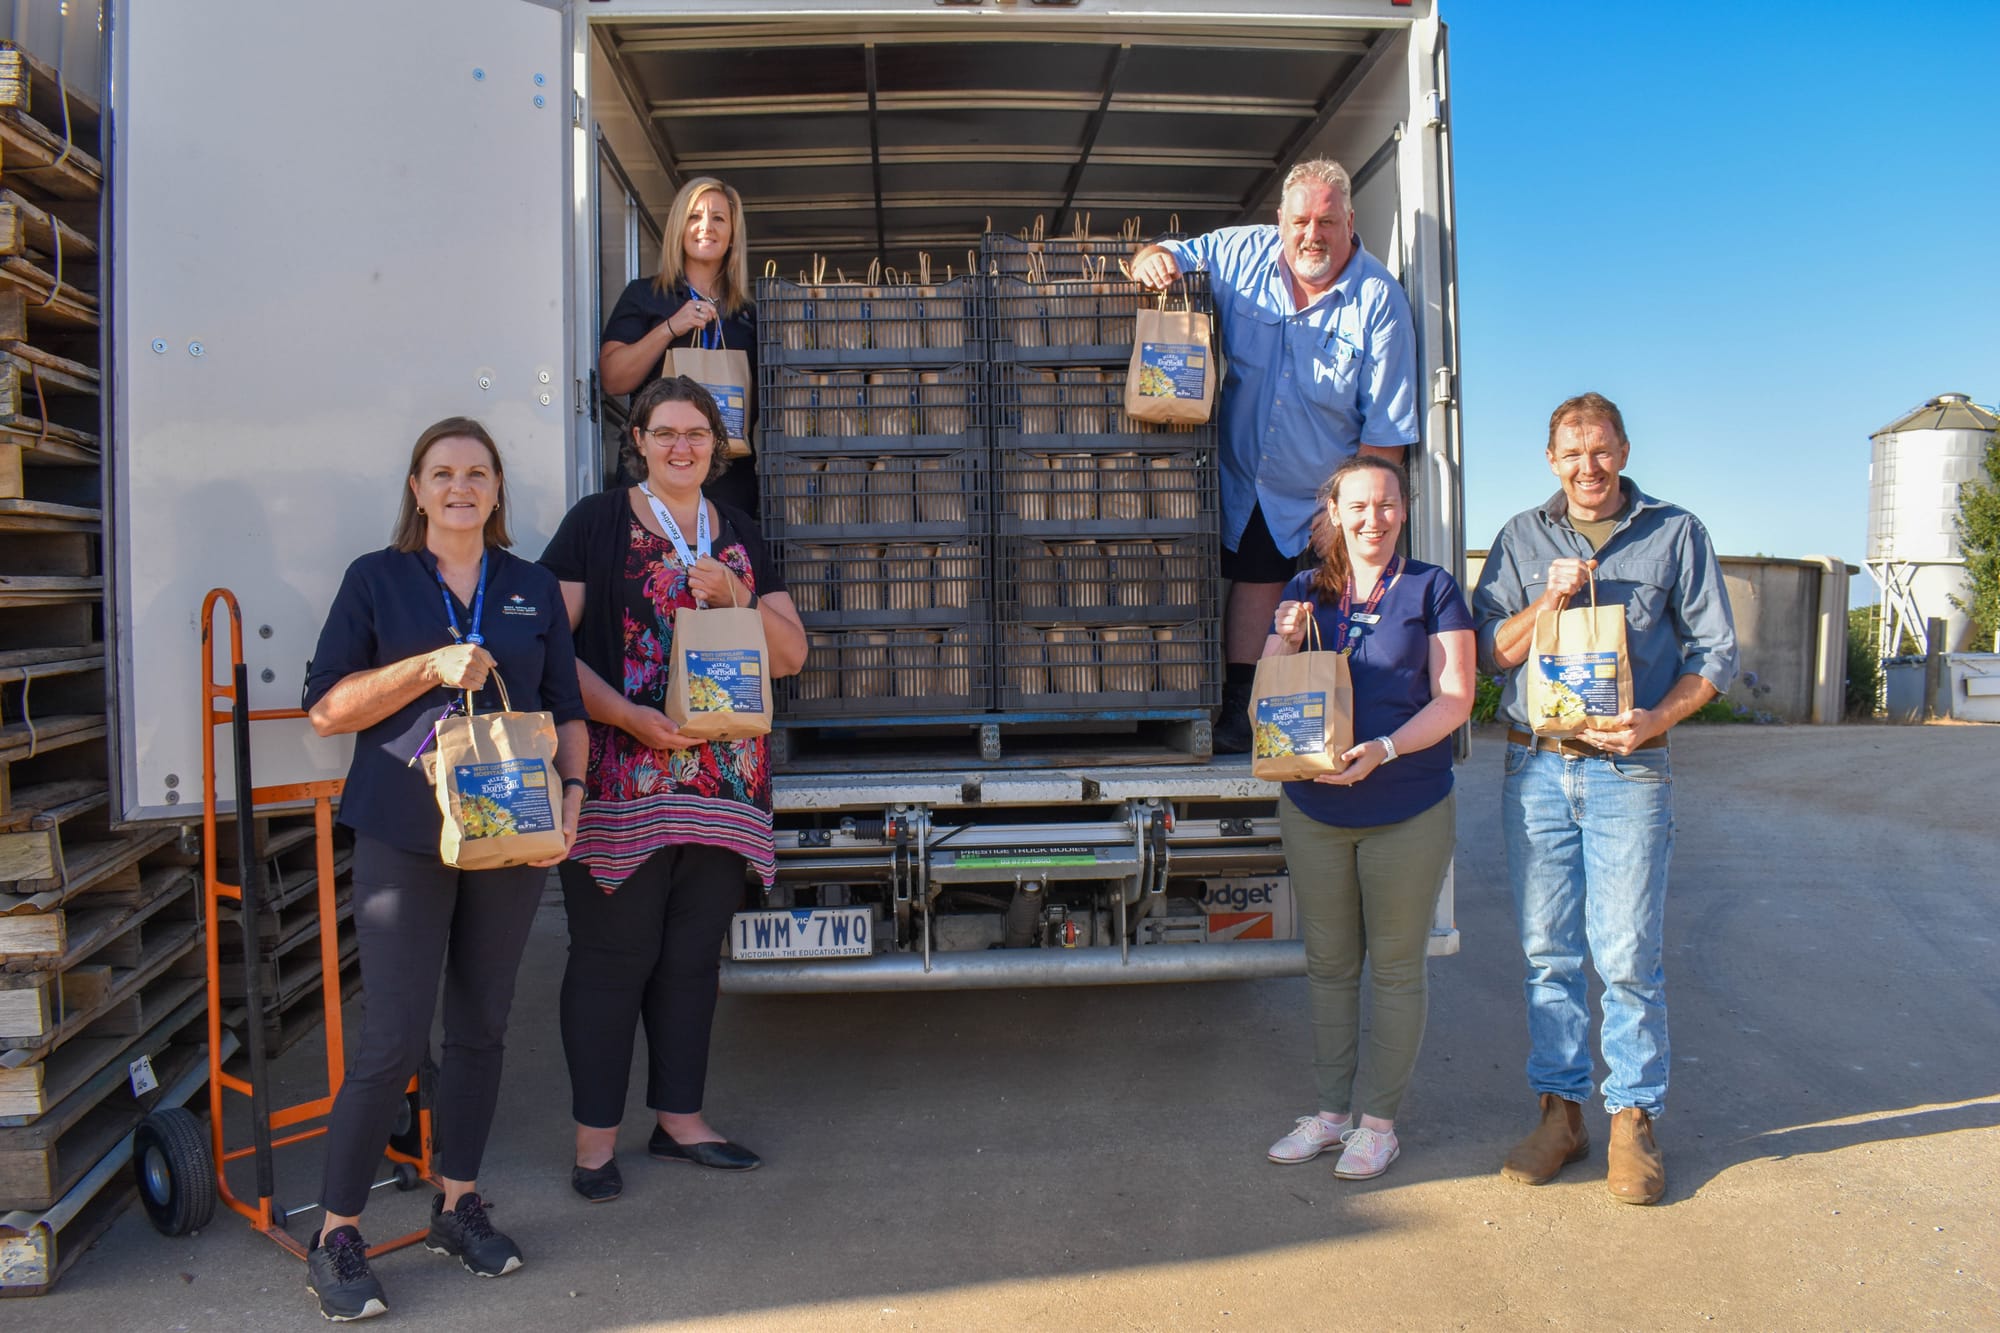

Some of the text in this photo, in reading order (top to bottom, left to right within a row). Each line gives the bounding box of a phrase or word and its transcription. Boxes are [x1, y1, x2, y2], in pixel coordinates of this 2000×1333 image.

[661, 510, 680, 540] Executive
[482, 780, 520, 793] Daffodil
[488, 776, 510, 784] MIXED
[1200, 883, 1273, 911] udget
[740, 915, 867, 949] 1WM 7WQ
